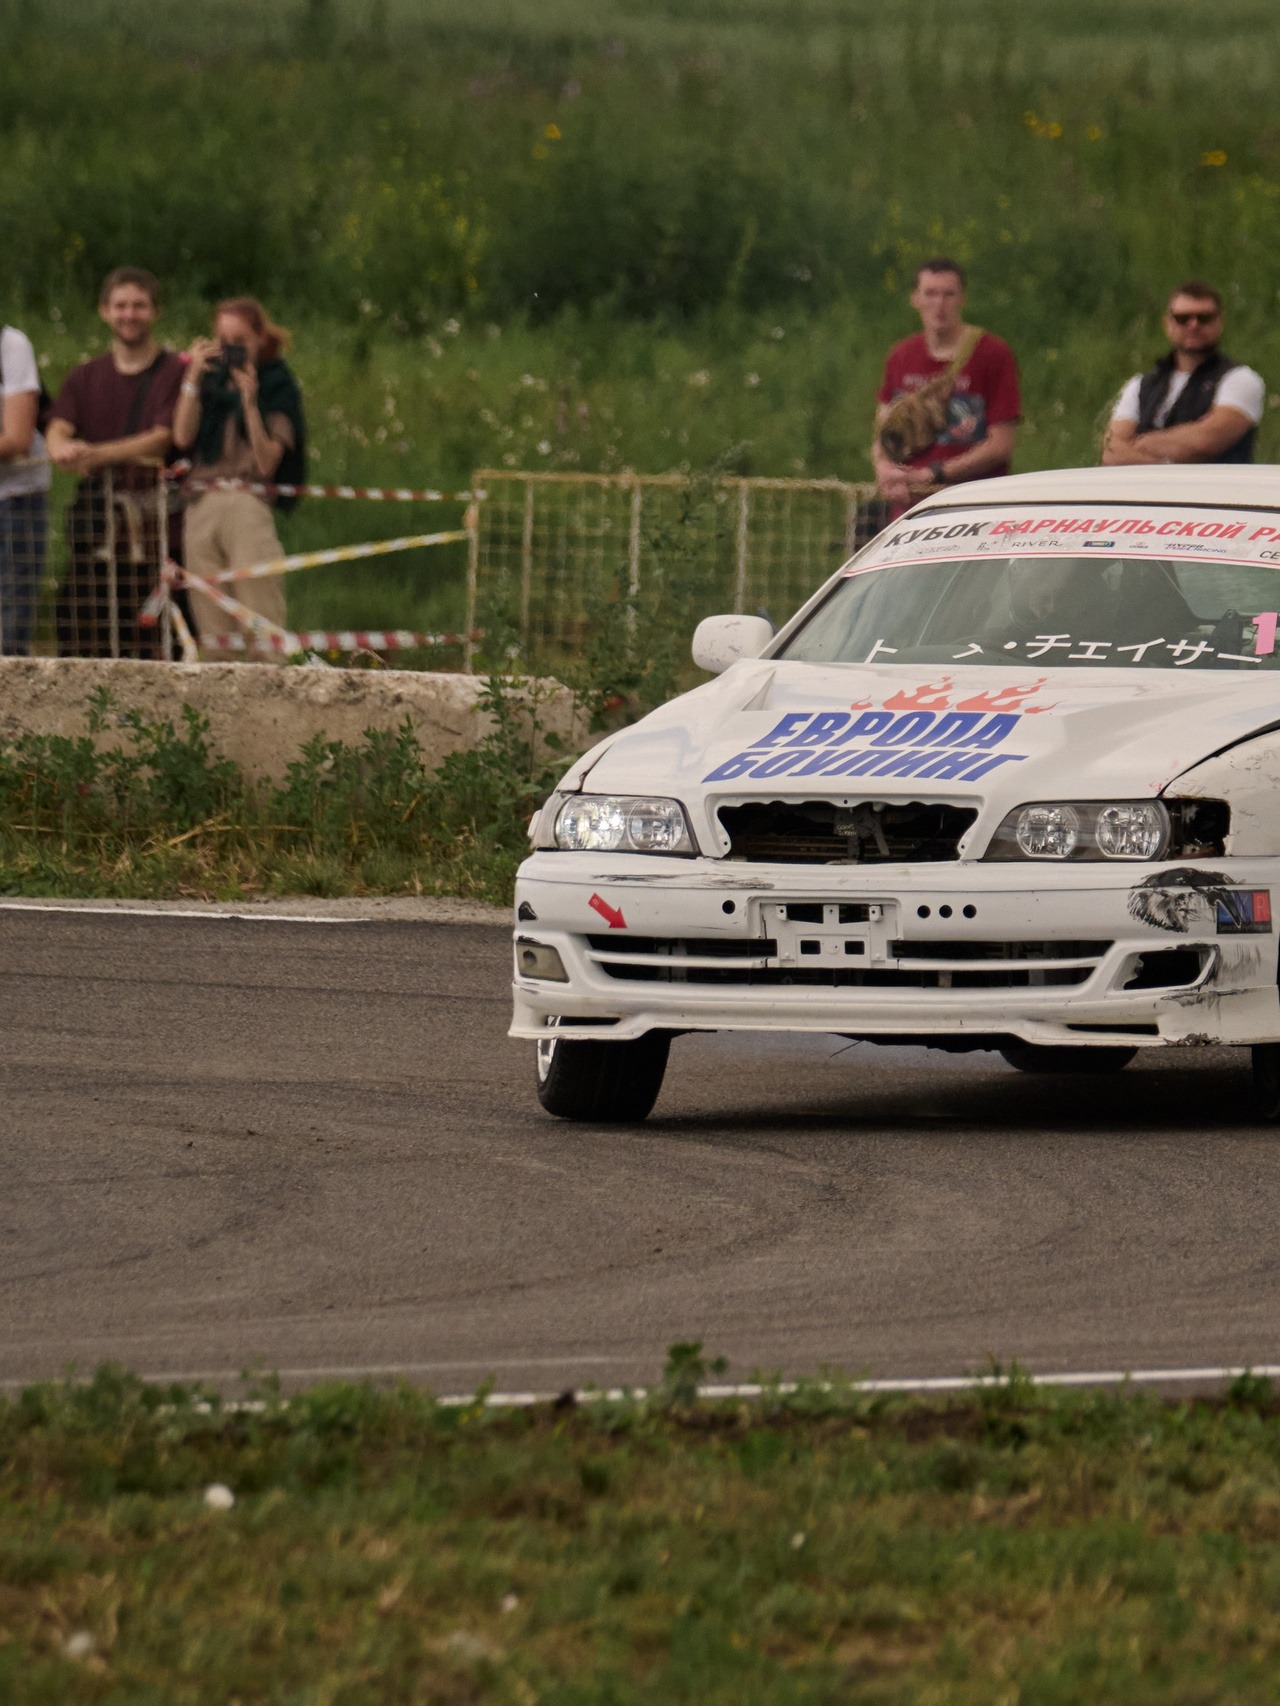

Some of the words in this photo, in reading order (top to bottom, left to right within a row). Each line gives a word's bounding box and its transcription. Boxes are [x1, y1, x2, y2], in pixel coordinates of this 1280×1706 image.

[883, 521, 992, 549] КУБОК
[989, 518, 1248, 539] БАРНАУЛЬСКОЙ
[1012, 540, 1063, 548] RIVER
[746, 711, 1022, 749] ЕВРОПА
[700, 749, 1030, 784] БОУЛИНГ
